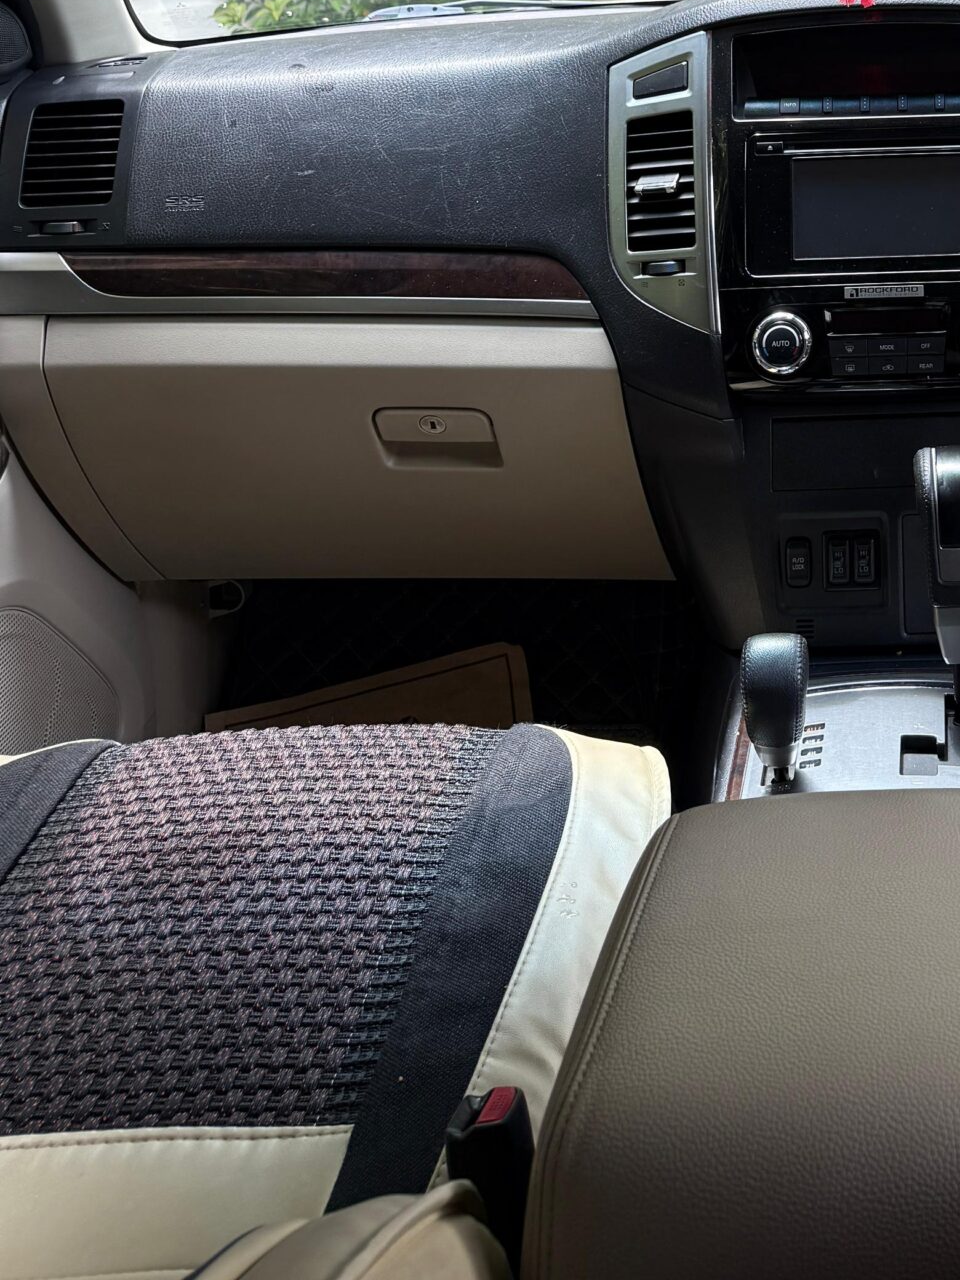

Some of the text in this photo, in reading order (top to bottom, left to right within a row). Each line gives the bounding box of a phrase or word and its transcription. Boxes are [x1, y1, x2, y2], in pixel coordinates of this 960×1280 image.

[164, 194, 205, 205] SRS
[859, 286, 919, 295] ROCKFORD
[771, 339, 790, 348] AUTO
